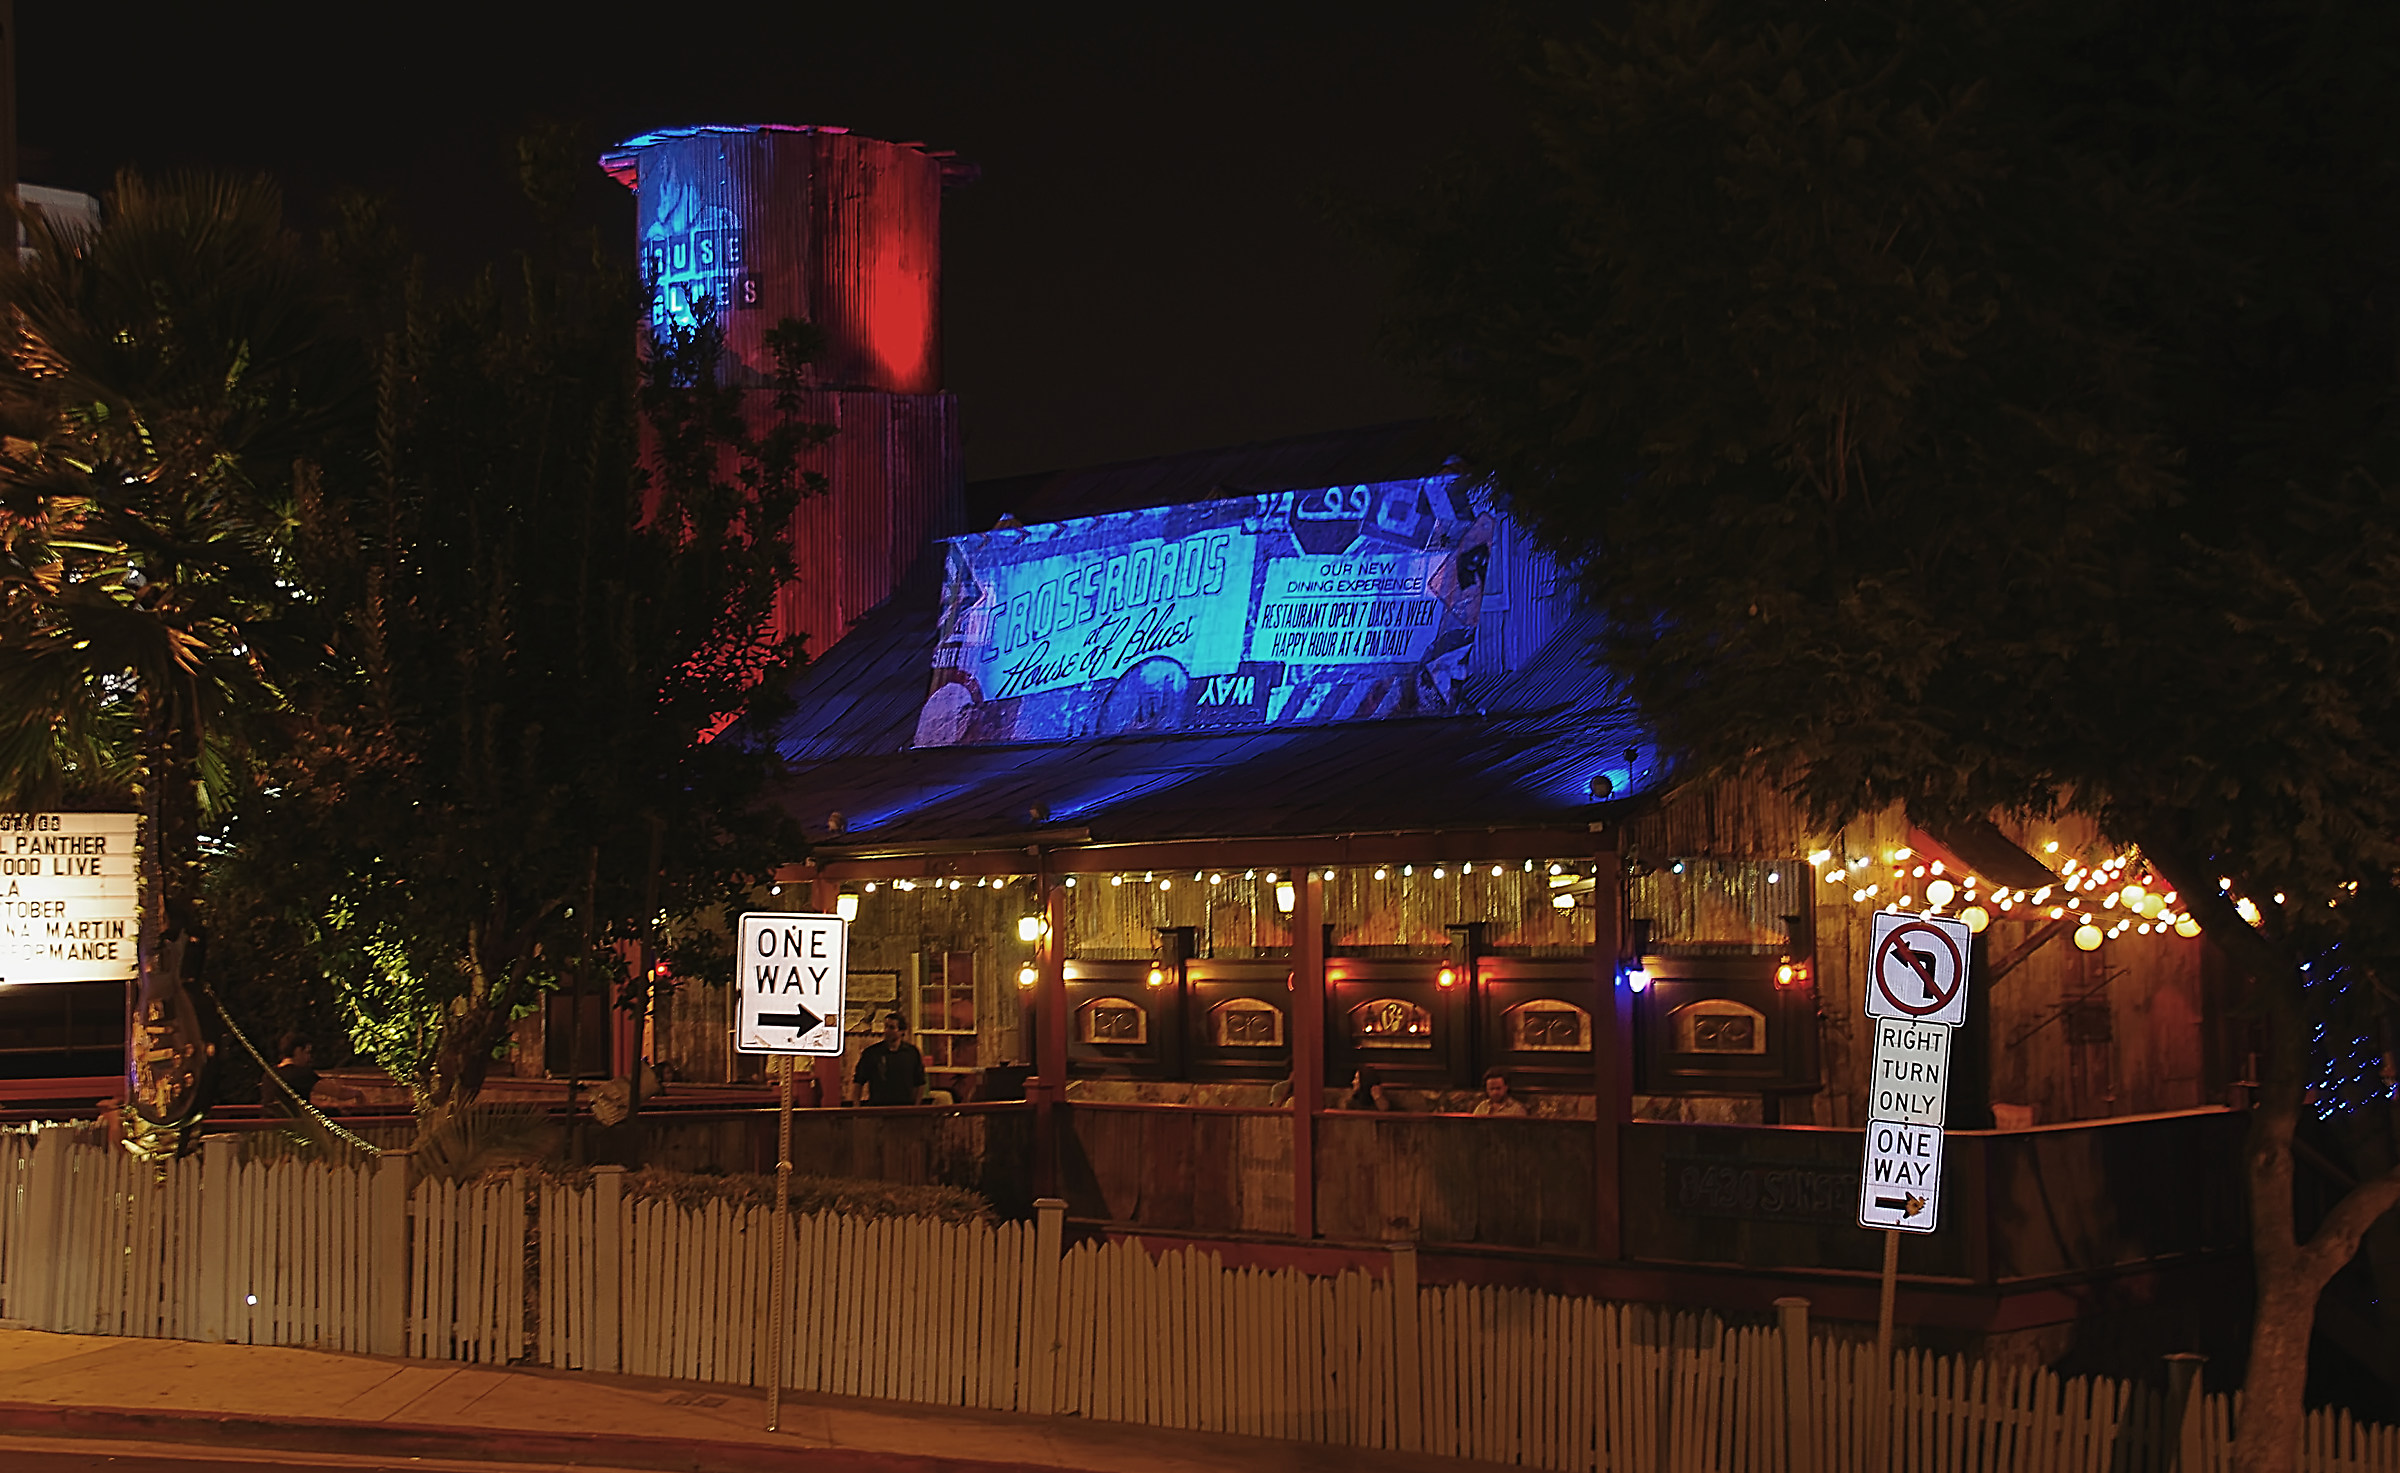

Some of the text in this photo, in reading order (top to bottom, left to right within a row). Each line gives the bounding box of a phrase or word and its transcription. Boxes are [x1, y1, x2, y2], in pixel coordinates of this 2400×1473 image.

[1320, 562, 1395, 577] OUR NEW
[1287, 577, 1423, 593] DINING EXPERIENCE
[980, 534, 1229, 664] CROSSROADS
[1261, 599, 1438, 630] RESTAURANT OPEN 7 DAYS A WEEK
[995, 639, 1079, 698] House
[1112, 602, 1196, 670] Blues
[1271, 630, 1413, 657] HAPPY HOUR AT 4 PM DAILY
[1197, 676, 1255, 707] WAY
[17, 836, 106, 855] PANTHER
[0, 857, 101, 876] OOD LIVE
[0, 900, 67, 919] TOBER
[47, 919, 125, 940] MARTIN
[758, 928, 827, 958] ONE
[756, 965, 829, 995] WAY
[1882, 1028, 1943, 1053] RIGHT
[1882, 1059, 1939, 1084] TURN
[1880, 1090, 1936, 1115] ONLY
[1877, 1129, 1931, 1158] ONE
[1874, 1158, 1931, 1186] WAY
